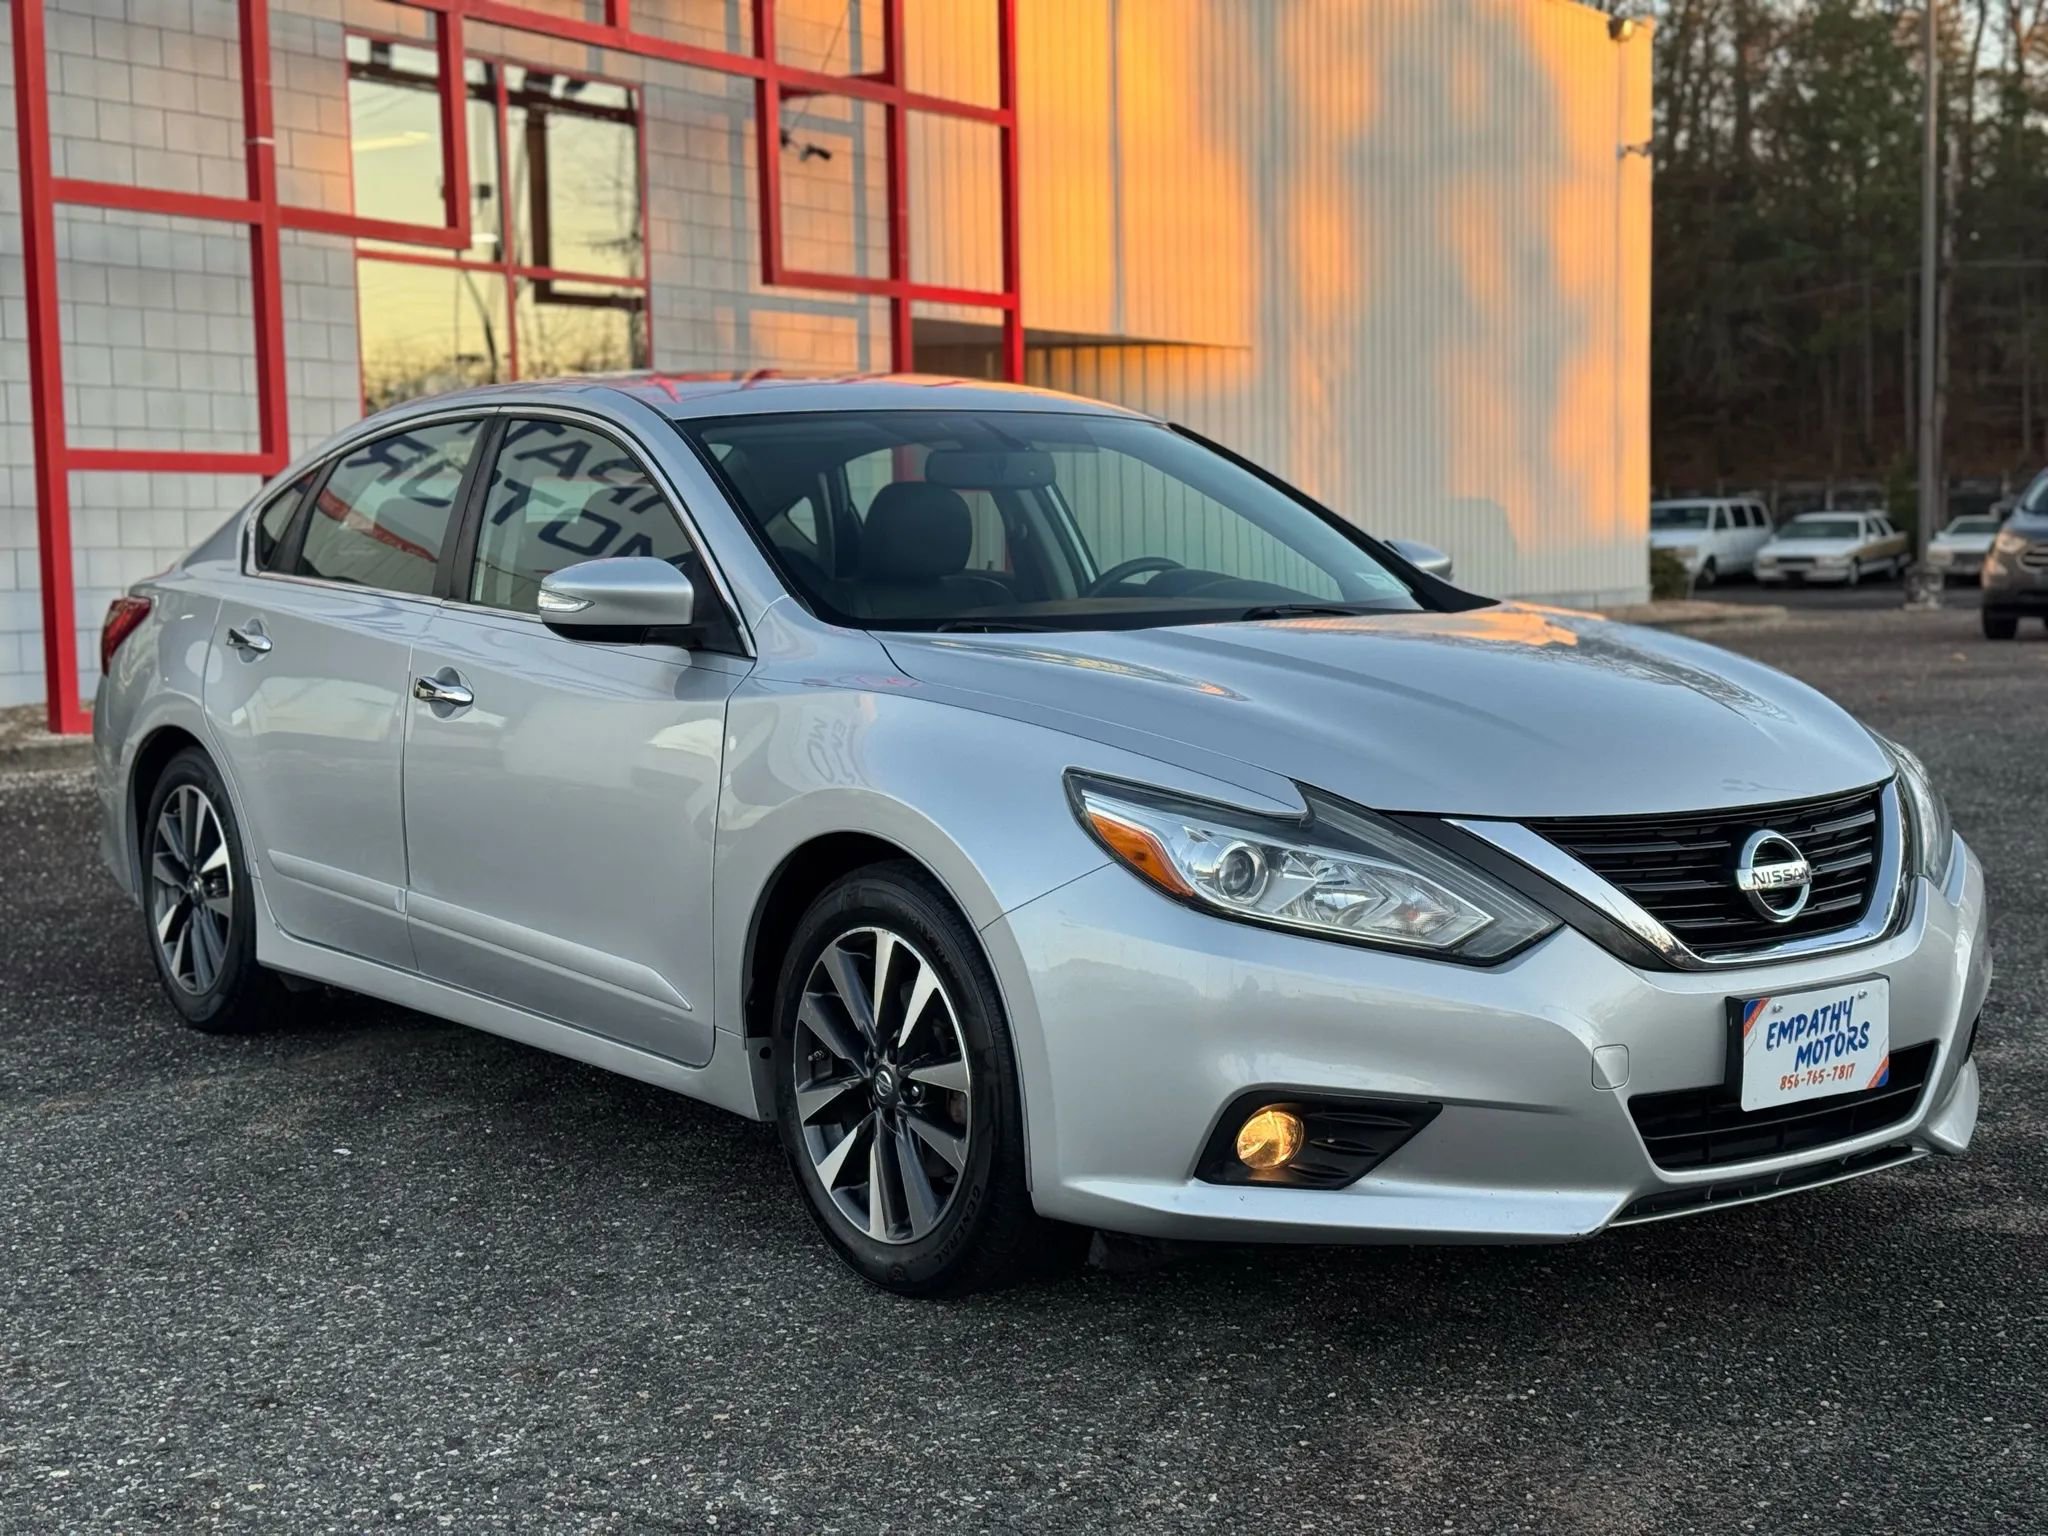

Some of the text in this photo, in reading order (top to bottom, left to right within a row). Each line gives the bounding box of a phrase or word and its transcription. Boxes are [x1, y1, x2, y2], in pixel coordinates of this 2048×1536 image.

[1751, 866, 1811, 885] NISSAN
[1766, 996, 1854, 1051] EMPATHY
[1794, 1021, 1871, 1072] MOTORS
[1780, 1063, 1856, 1091] 856-765-7817
